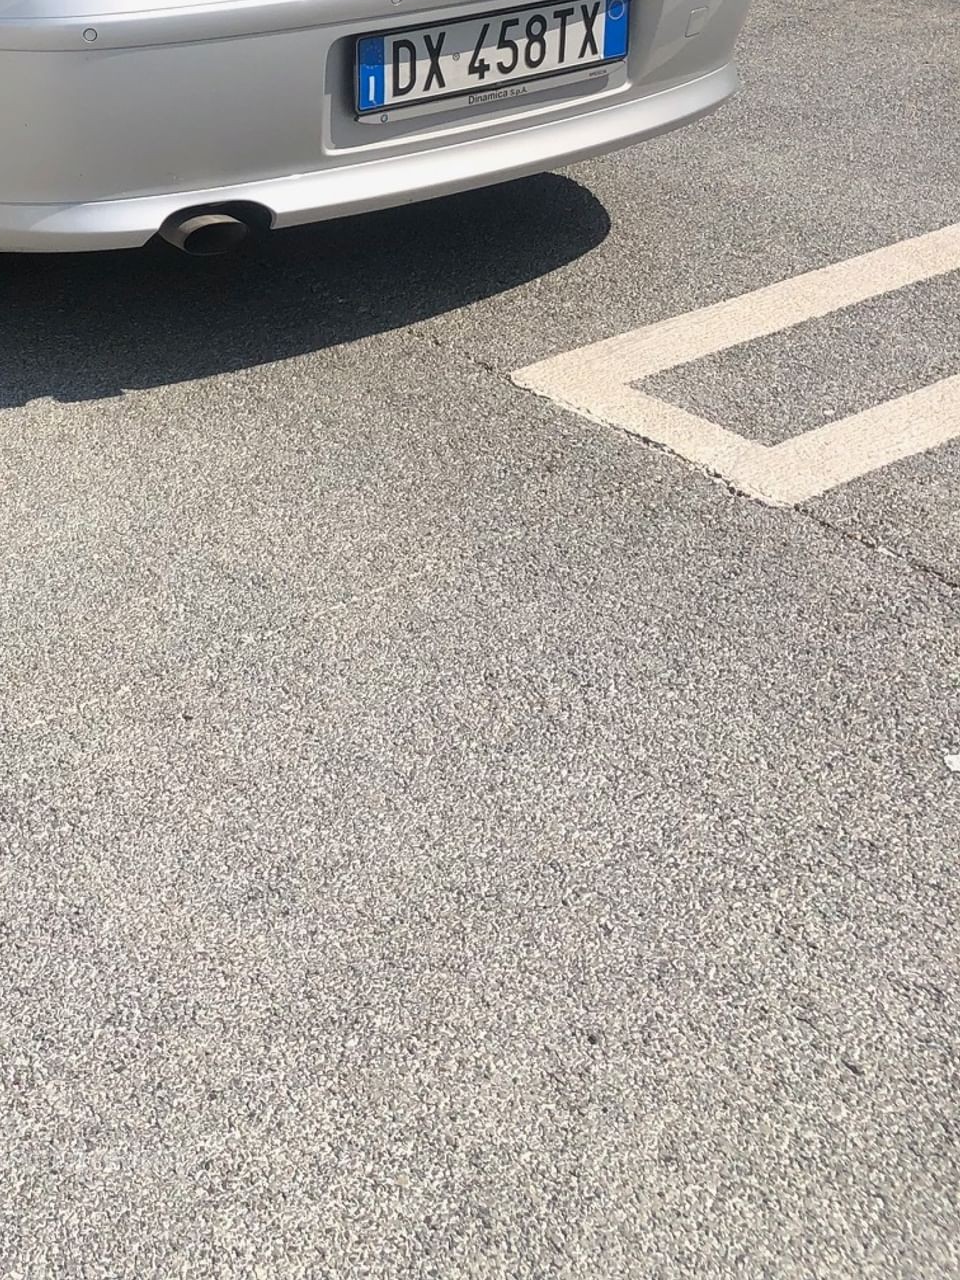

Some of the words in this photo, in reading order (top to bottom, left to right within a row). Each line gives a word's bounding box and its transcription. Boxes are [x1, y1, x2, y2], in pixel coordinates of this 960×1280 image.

[391, 31, 446, 98] DX
[467, 1, 601, 81] 458TX
[468, 88, 509, 105] Dinamica
